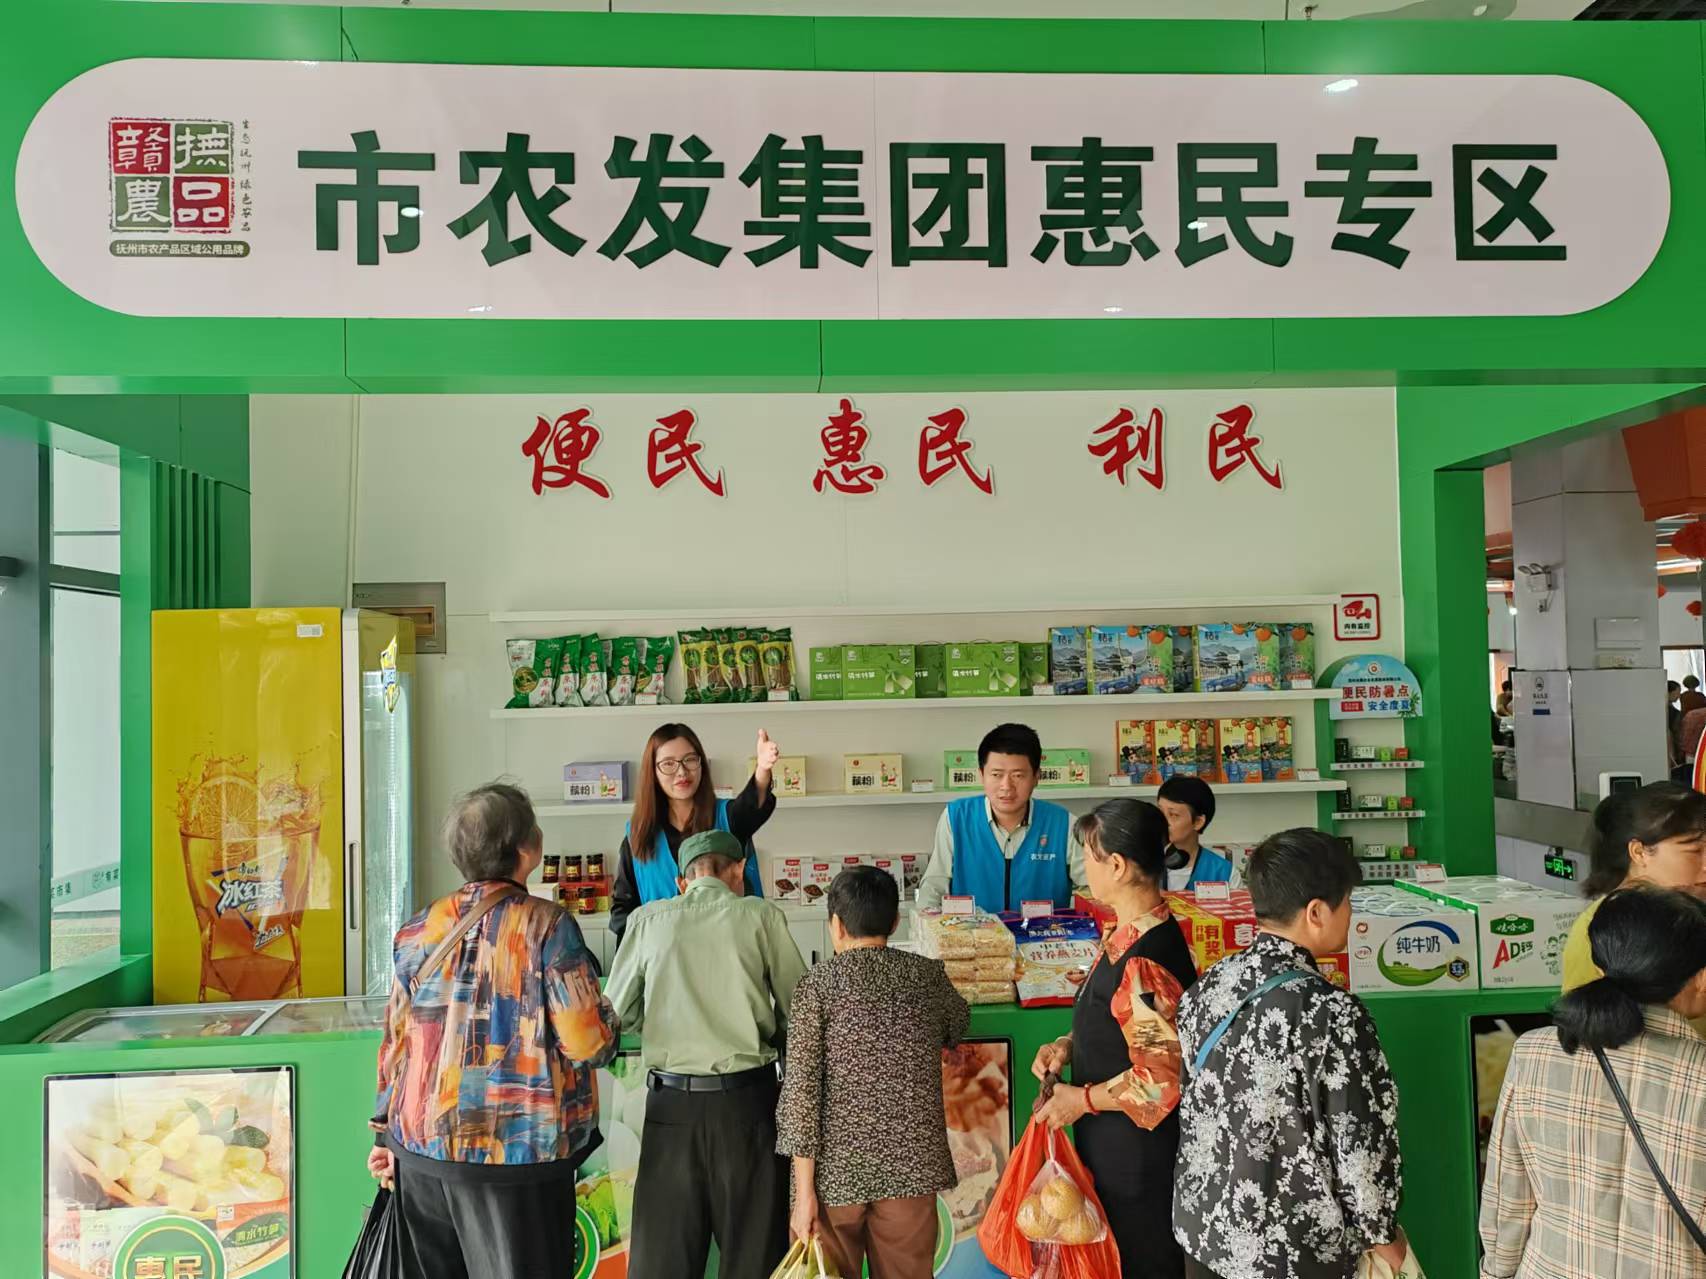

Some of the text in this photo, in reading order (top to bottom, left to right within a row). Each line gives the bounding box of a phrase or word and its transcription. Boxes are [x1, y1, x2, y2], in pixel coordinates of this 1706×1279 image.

[297, 129, 1567, 270] 市农发集团惠民专区
[115, 243, 245, 256] 抚州市农产品区域公用品牌
[520, 397, 1283, 499] 便民 惠民 利民
[569, 783, 591, 796] 藕粉
[852, 775, 872, 787] 藕粉
[216, 881, 283, 916] 冰红茶
[1396, 935, 1441, 955] 纯牛奶
